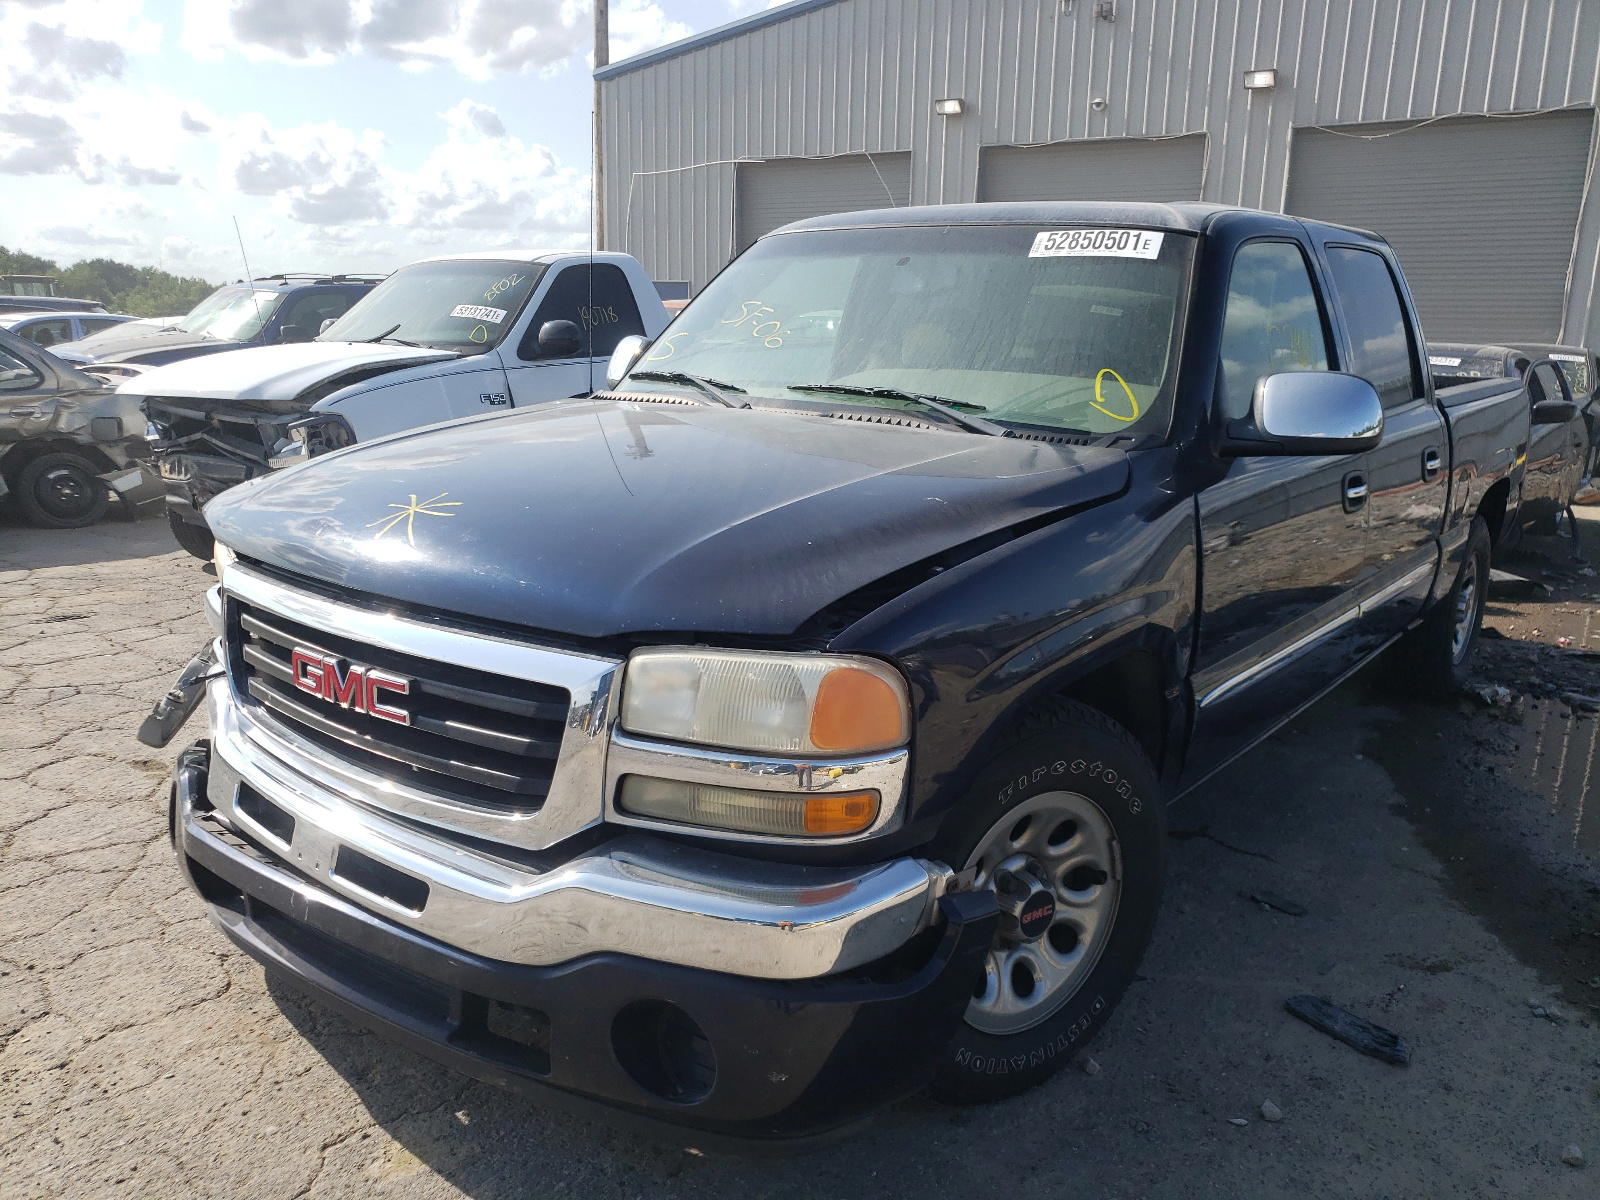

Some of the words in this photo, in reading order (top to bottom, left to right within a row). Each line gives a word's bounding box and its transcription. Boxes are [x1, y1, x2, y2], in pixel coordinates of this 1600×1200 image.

[292, 646, 411, 727] GMC
[998, 758, 1143, 815] Firestone
[1022, 904, 1053, 925] GMC
[954, 995, 1106, 1074] DESTINATION
